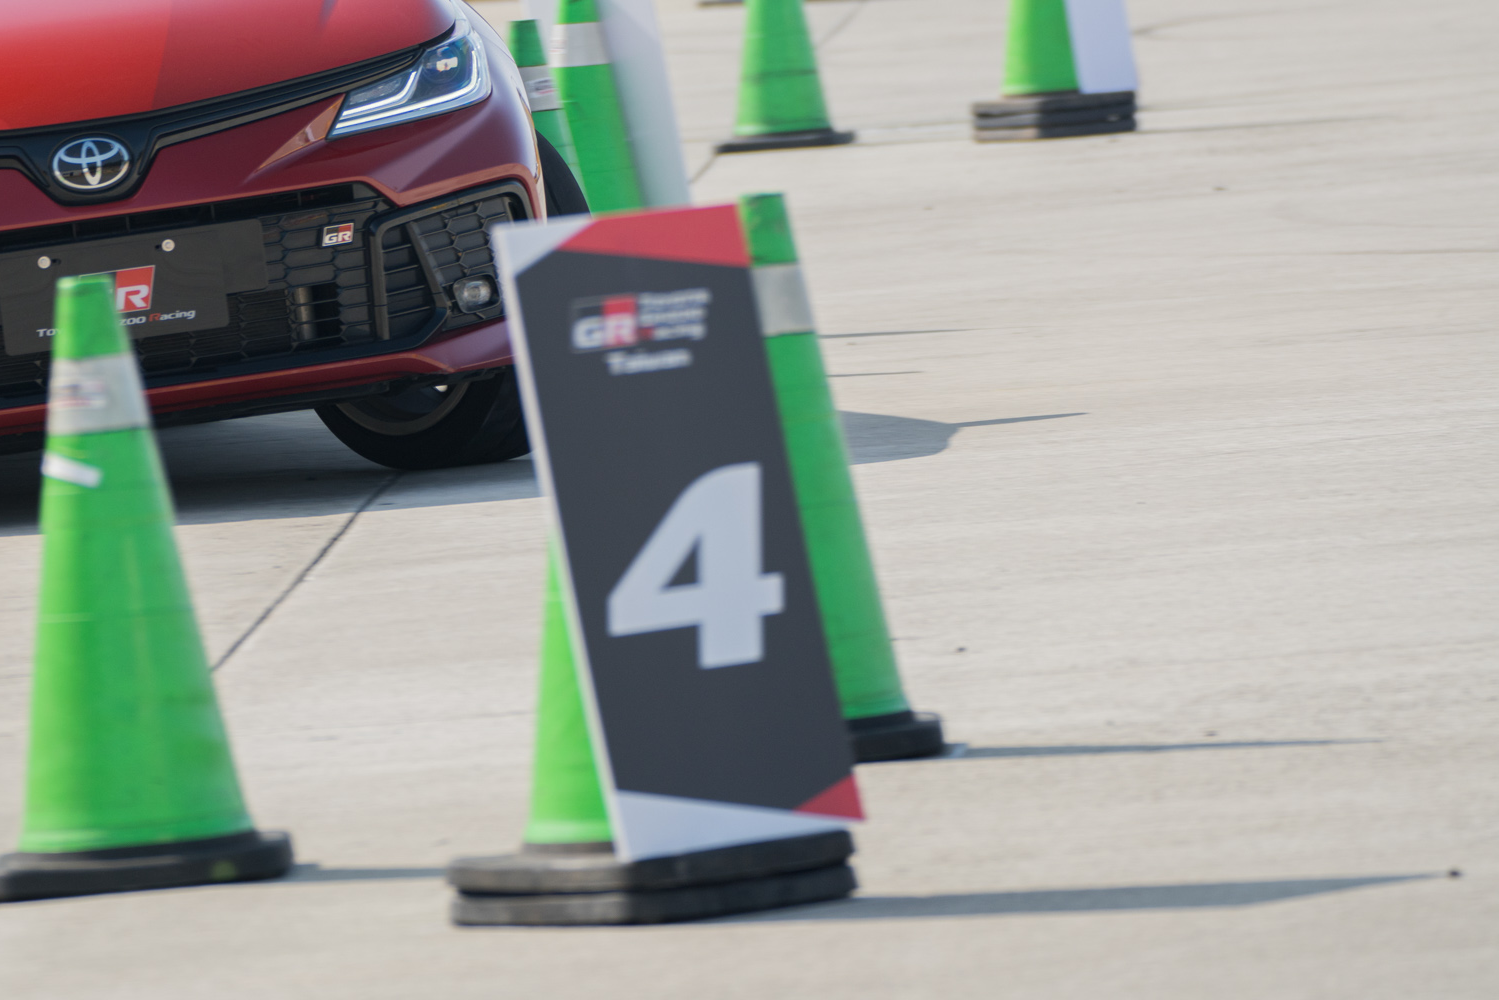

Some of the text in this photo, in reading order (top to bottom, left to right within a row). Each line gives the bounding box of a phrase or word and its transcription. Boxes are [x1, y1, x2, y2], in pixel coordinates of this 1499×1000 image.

[325, 231, 351, 244] GR
[149, 310, 196, 322] Racing
[572, 311, 638, 349] GR
[606, 462, 786, 670] 4
